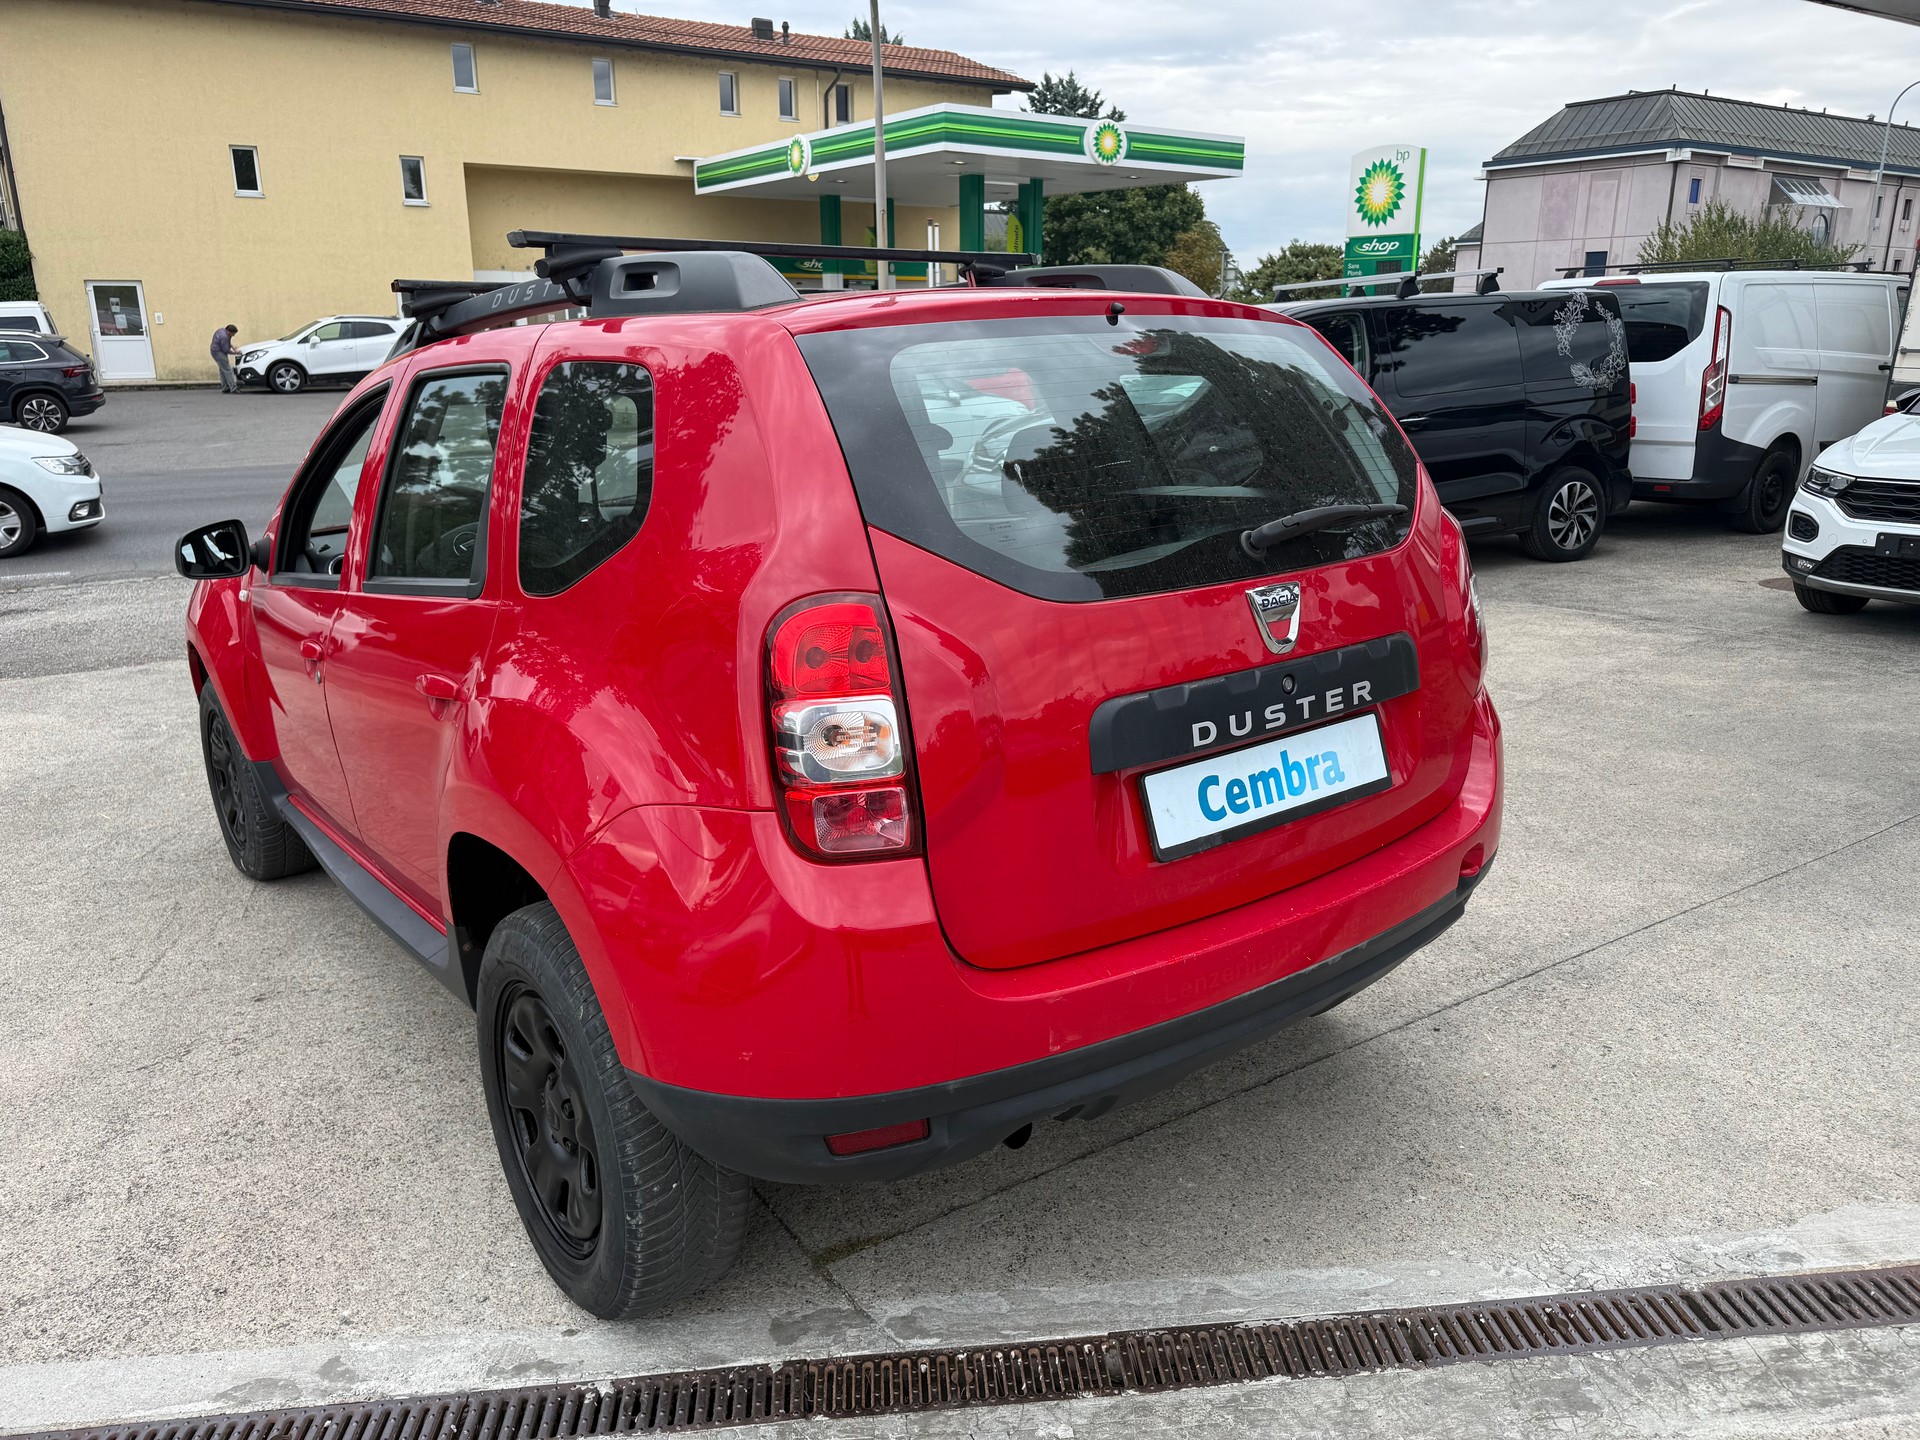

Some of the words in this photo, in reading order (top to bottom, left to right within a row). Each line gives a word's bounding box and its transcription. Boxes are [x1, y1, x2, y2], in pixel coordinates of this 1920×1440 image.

[1396, 149, 1410, 164] bp
[1361, 238, 1399, 255] shop
[803, 258, 823, 270] sho
[1261, 593, 1298, 608] DACIA
[1191, 680, 1373, 747] DUSTER
[1197, 749, 1346, 822] Cembra
